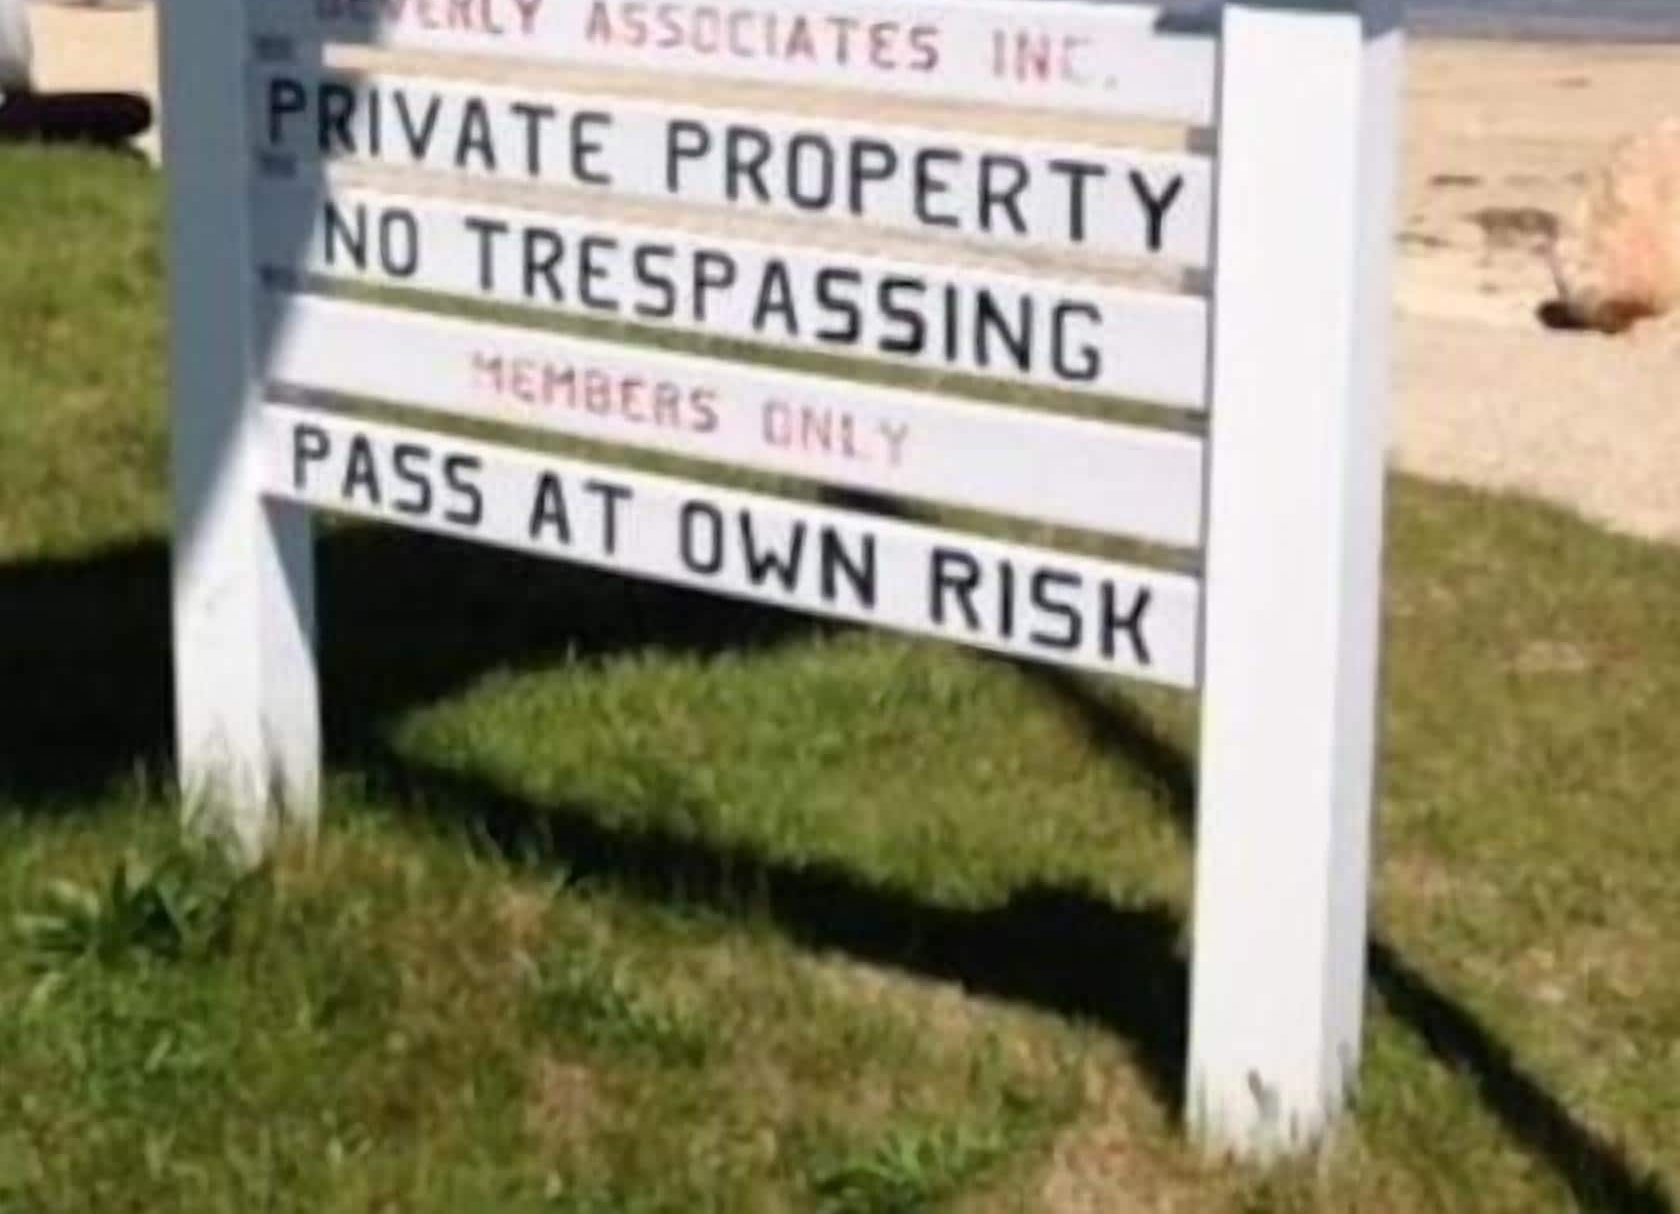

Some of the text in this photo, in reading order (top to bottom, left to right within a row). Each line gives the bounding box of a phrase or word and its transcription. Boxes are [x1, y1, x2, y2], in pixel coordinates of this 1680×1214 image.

[266, 78, 1186, 252] PRIVATE PROPERTY
[321, 202, 1104, 383] NO TRESPASSING
[470, 351, 914, 469] MEMBERS ONLY
[292, 423, 1155, 666] PASS AT OWN RISK
